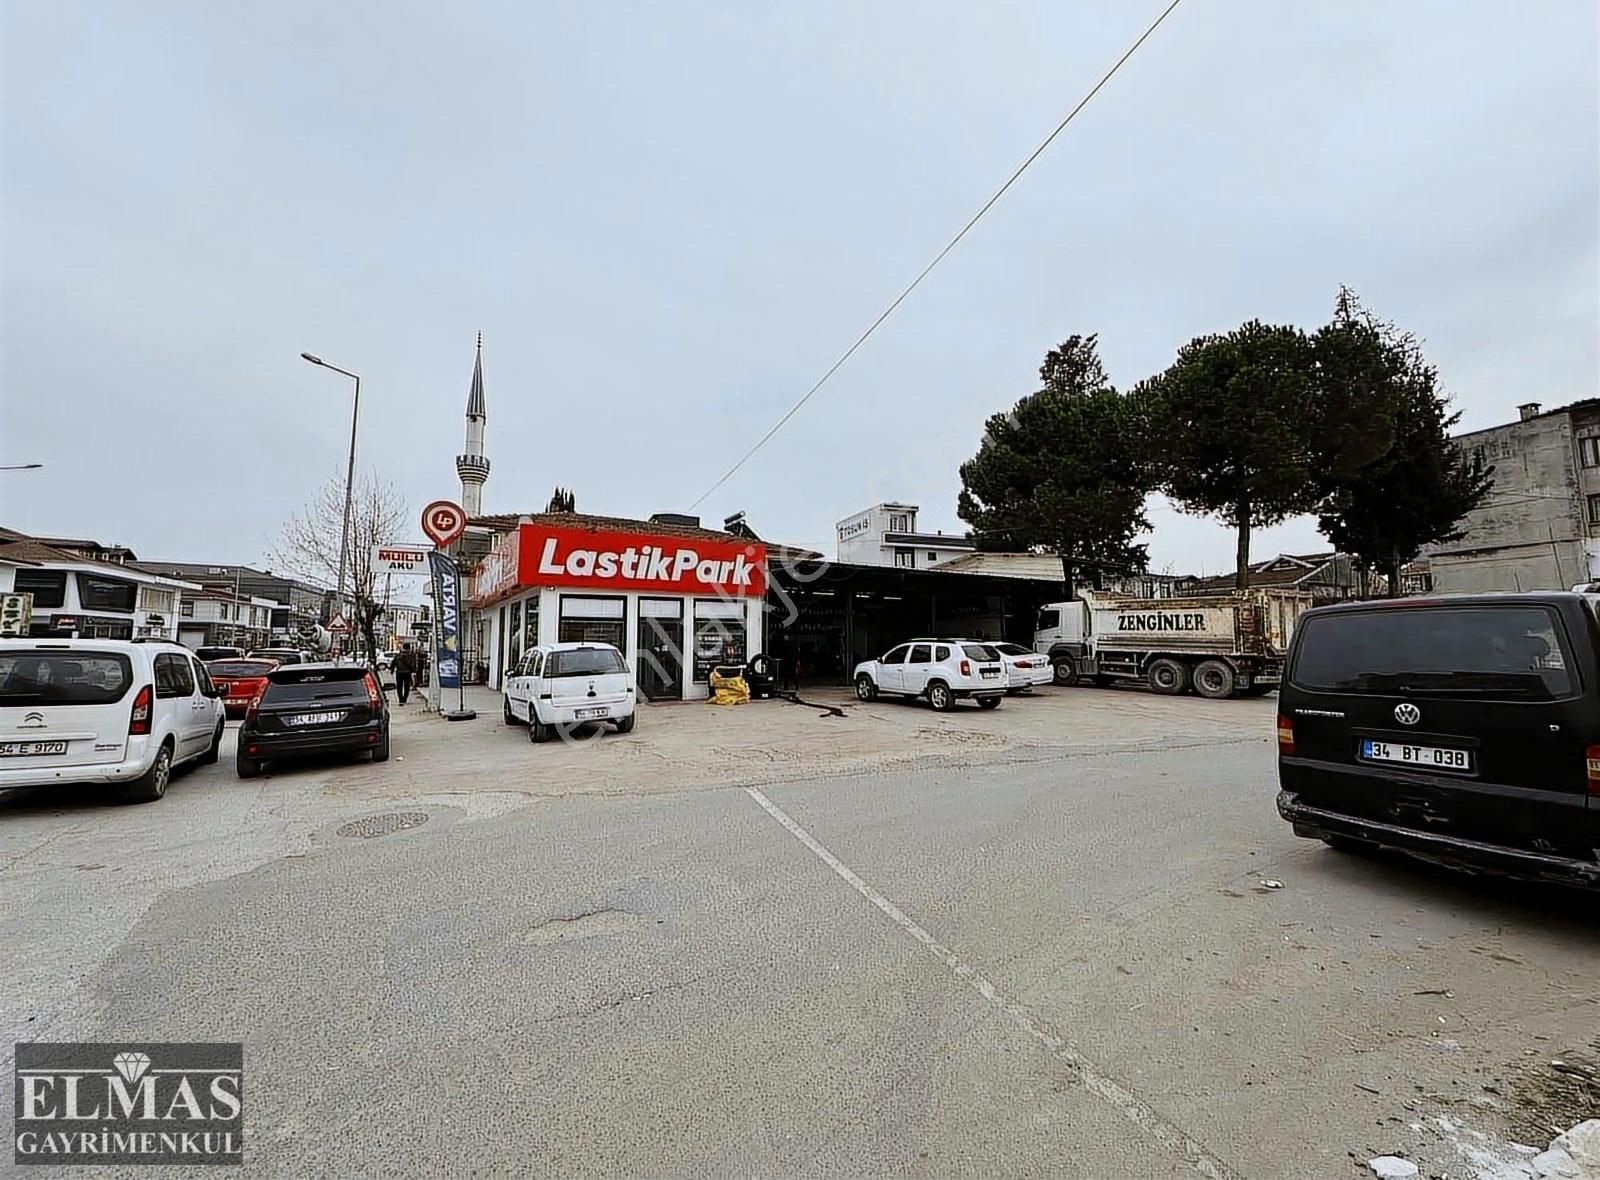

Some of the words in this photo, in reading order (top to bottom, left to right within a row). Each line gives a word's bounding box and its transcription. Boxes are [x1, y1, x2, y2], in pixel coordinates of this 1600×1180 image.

[538, 538, 756, 586] LastikPark
[1118, 611, 1206, 632] ZENGİNLER
[19, 743, 29, 754] E
[34, 743, 64, 754] 9170
[1373, 743, 1391, 759] 34
[1402, 746, 1422, 761] BT
[1433, 750, 1465, 766] 038
